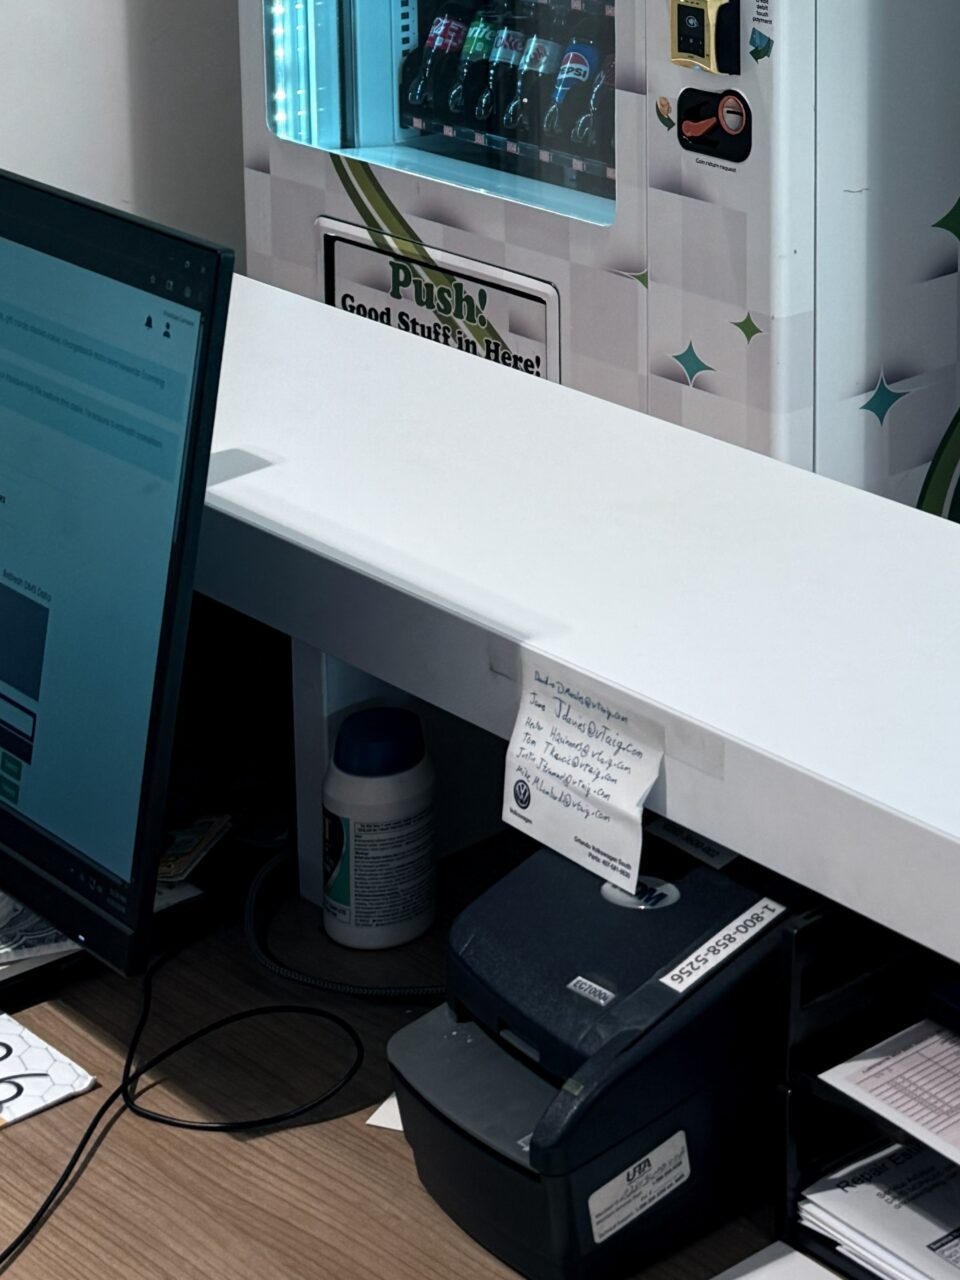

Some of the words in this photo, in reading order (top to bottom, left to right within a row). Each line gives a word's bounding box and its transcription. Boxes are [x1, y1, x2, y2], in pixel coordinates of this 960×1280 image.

[389, 260, 488, 328] Push!
[341, 293, 392, 326] Good
[398, 312, 450, 346] Stuff
[456, 331, 478, 356] in
[484, 338, 542, 378] Here!
[670, 903, 777, 984] 1-800-858-5256
